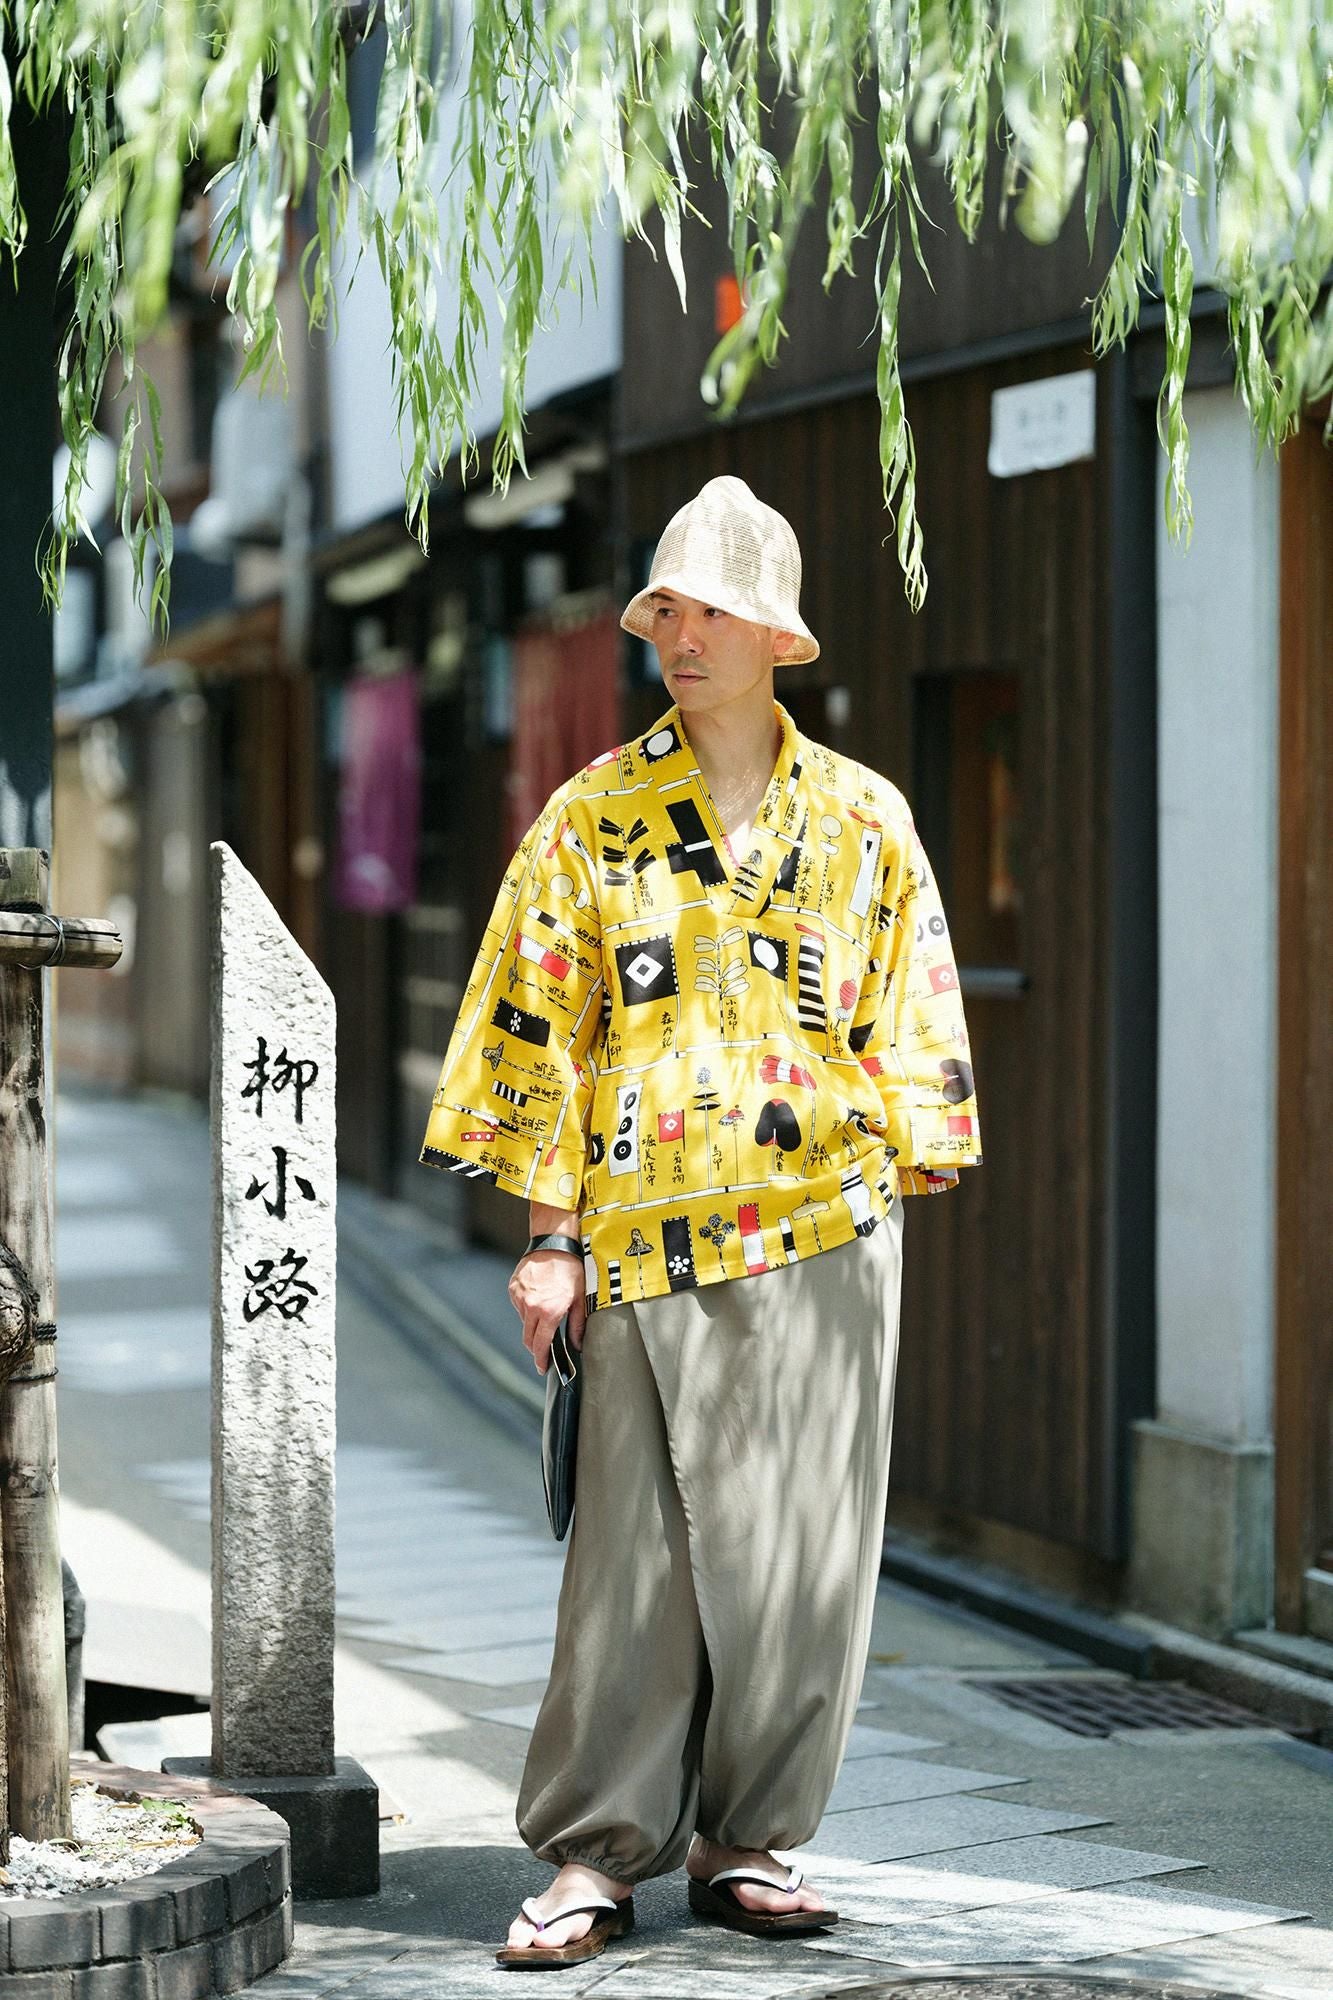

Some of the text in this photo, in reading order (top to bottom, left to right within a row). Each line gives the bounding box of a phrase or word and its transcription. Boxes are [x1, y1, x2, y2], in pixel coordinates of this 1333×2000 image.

[725, 999, 738, 1031] 小馬印
[609, 1032, 622, 1057] 馬印
[533, 1061, 561, 1077] 馬印
[712, 1144, 723, 1171] 馬印
[240, 1035, 319, 1324] 柳小路
